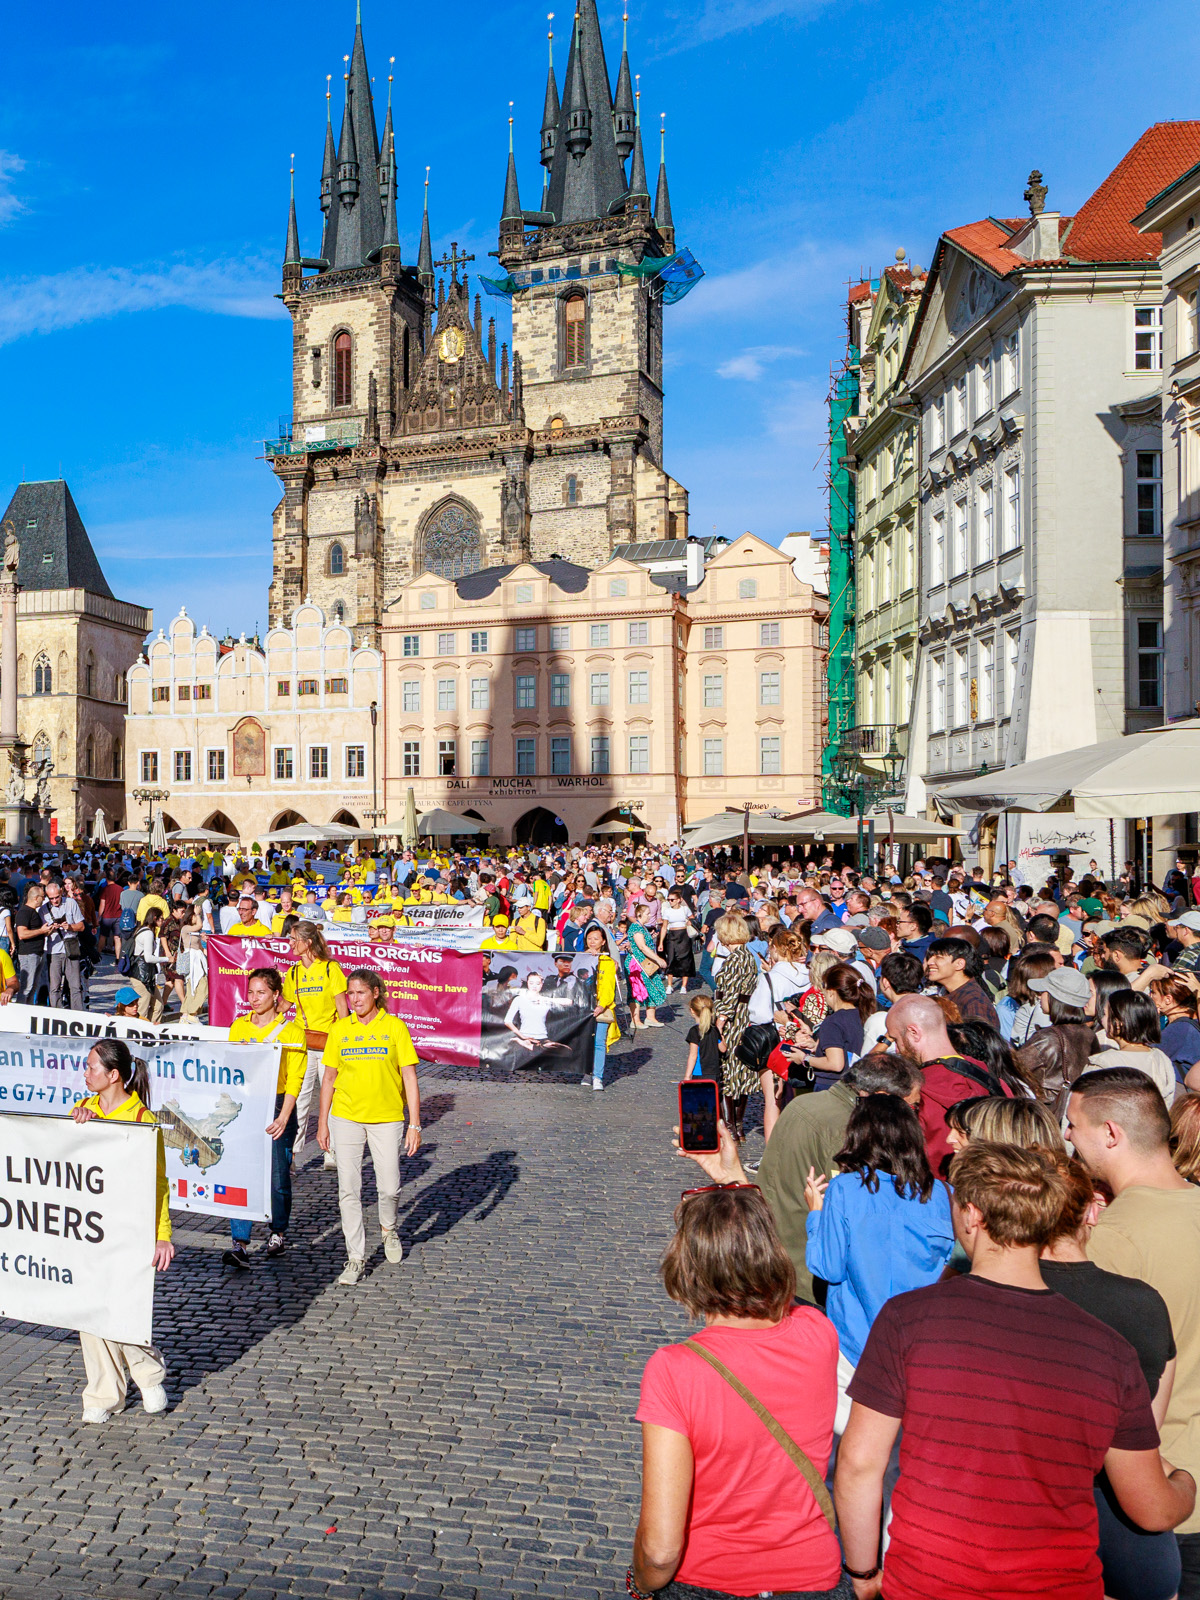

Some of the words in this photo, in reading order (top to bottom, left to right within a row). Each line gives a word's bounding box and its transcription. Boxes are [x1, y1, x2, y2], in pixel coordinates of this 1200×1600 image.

[492, 778, 533, 788] MUCHA
[557, 777, 605, 787] WARHOL
[488, 788, 537, 796] exhibition
[742, 801, 770, 810] Moser
[407, 909, 465, 920] staatliche
[241, 938, 291, 955] KILLED
[328, 944, 371, 958] THEIR
[374, 947, 443, 964] ORGANS
[444, 984, 469, 993] have
[391, 991, 419, 1001] China
[413, 1015, 442, 1024] onwards,
[156, 1055, 176, 1080] in
[182, 1057, 246, 1087] China
[12, 1083, 57, 1105] G7+7
[6, 1154, 105, 1195] LIVING
[13, 1253, 74, 1285] China
